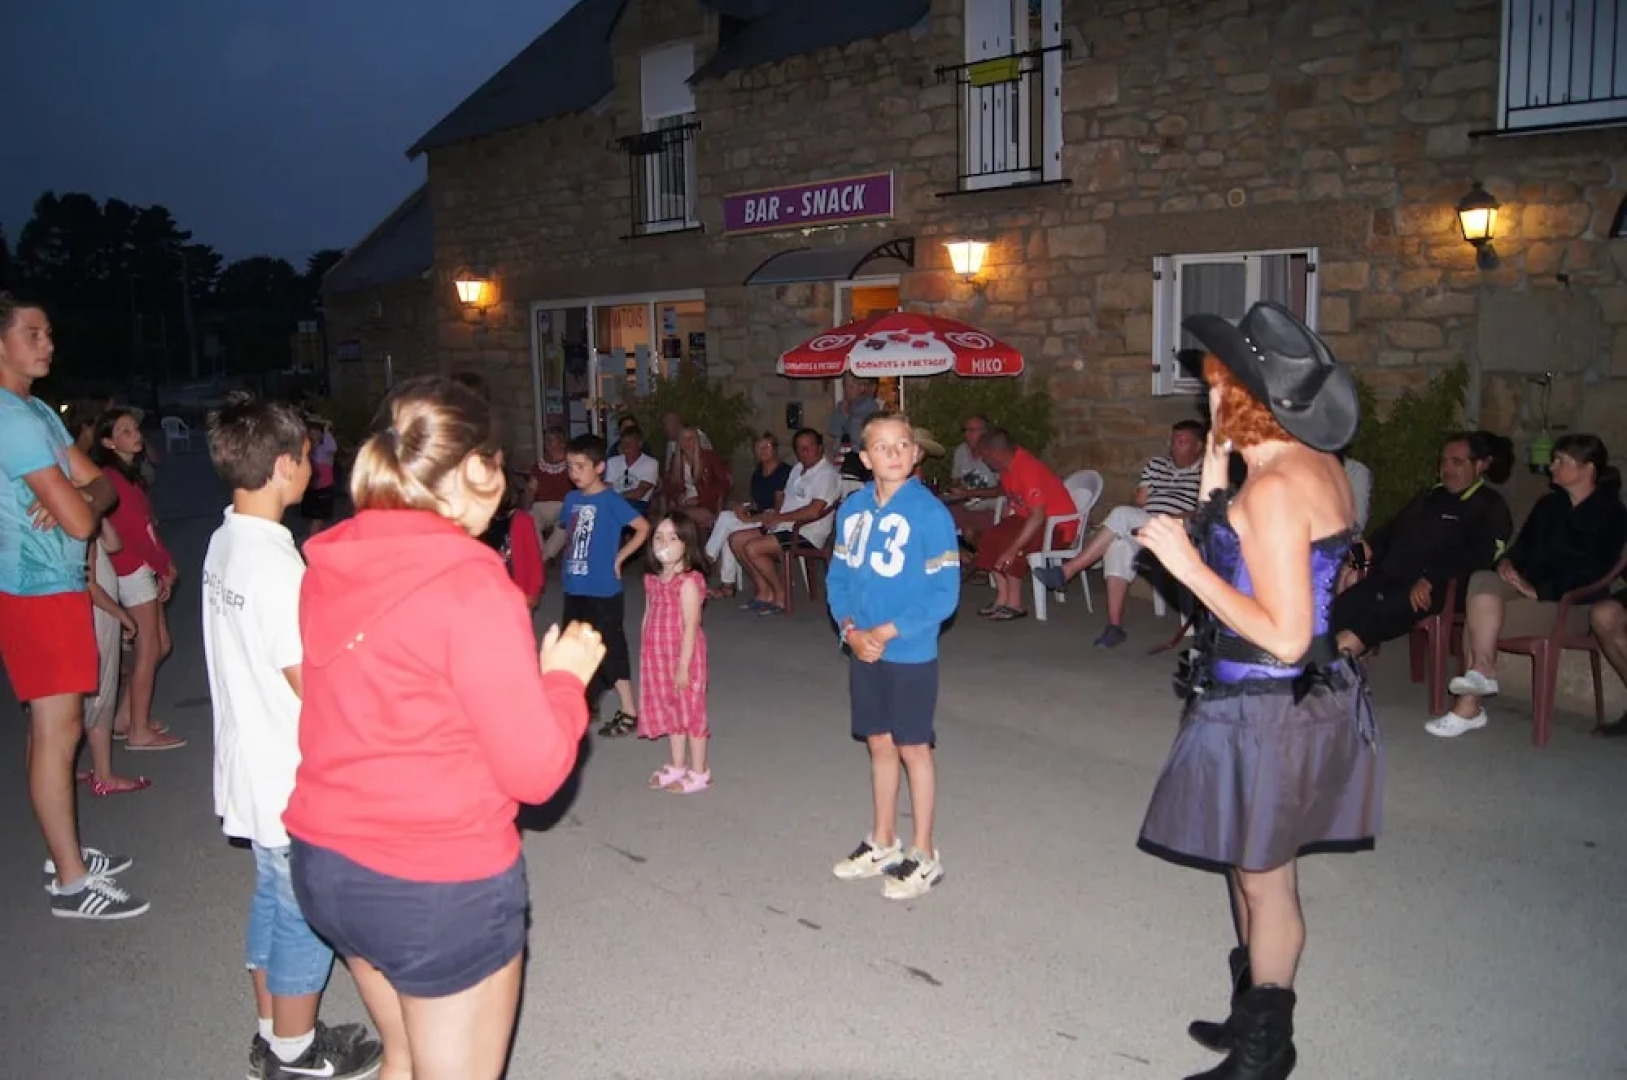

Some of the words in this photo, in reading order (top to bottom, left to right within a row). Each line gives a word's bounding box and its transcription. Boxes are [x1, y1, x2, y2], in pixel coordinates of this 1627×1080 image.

[744, 196, 780, 224] BAR
[801, 183, 867, 217] SNACK
[843, 510, 911, 578] 03
